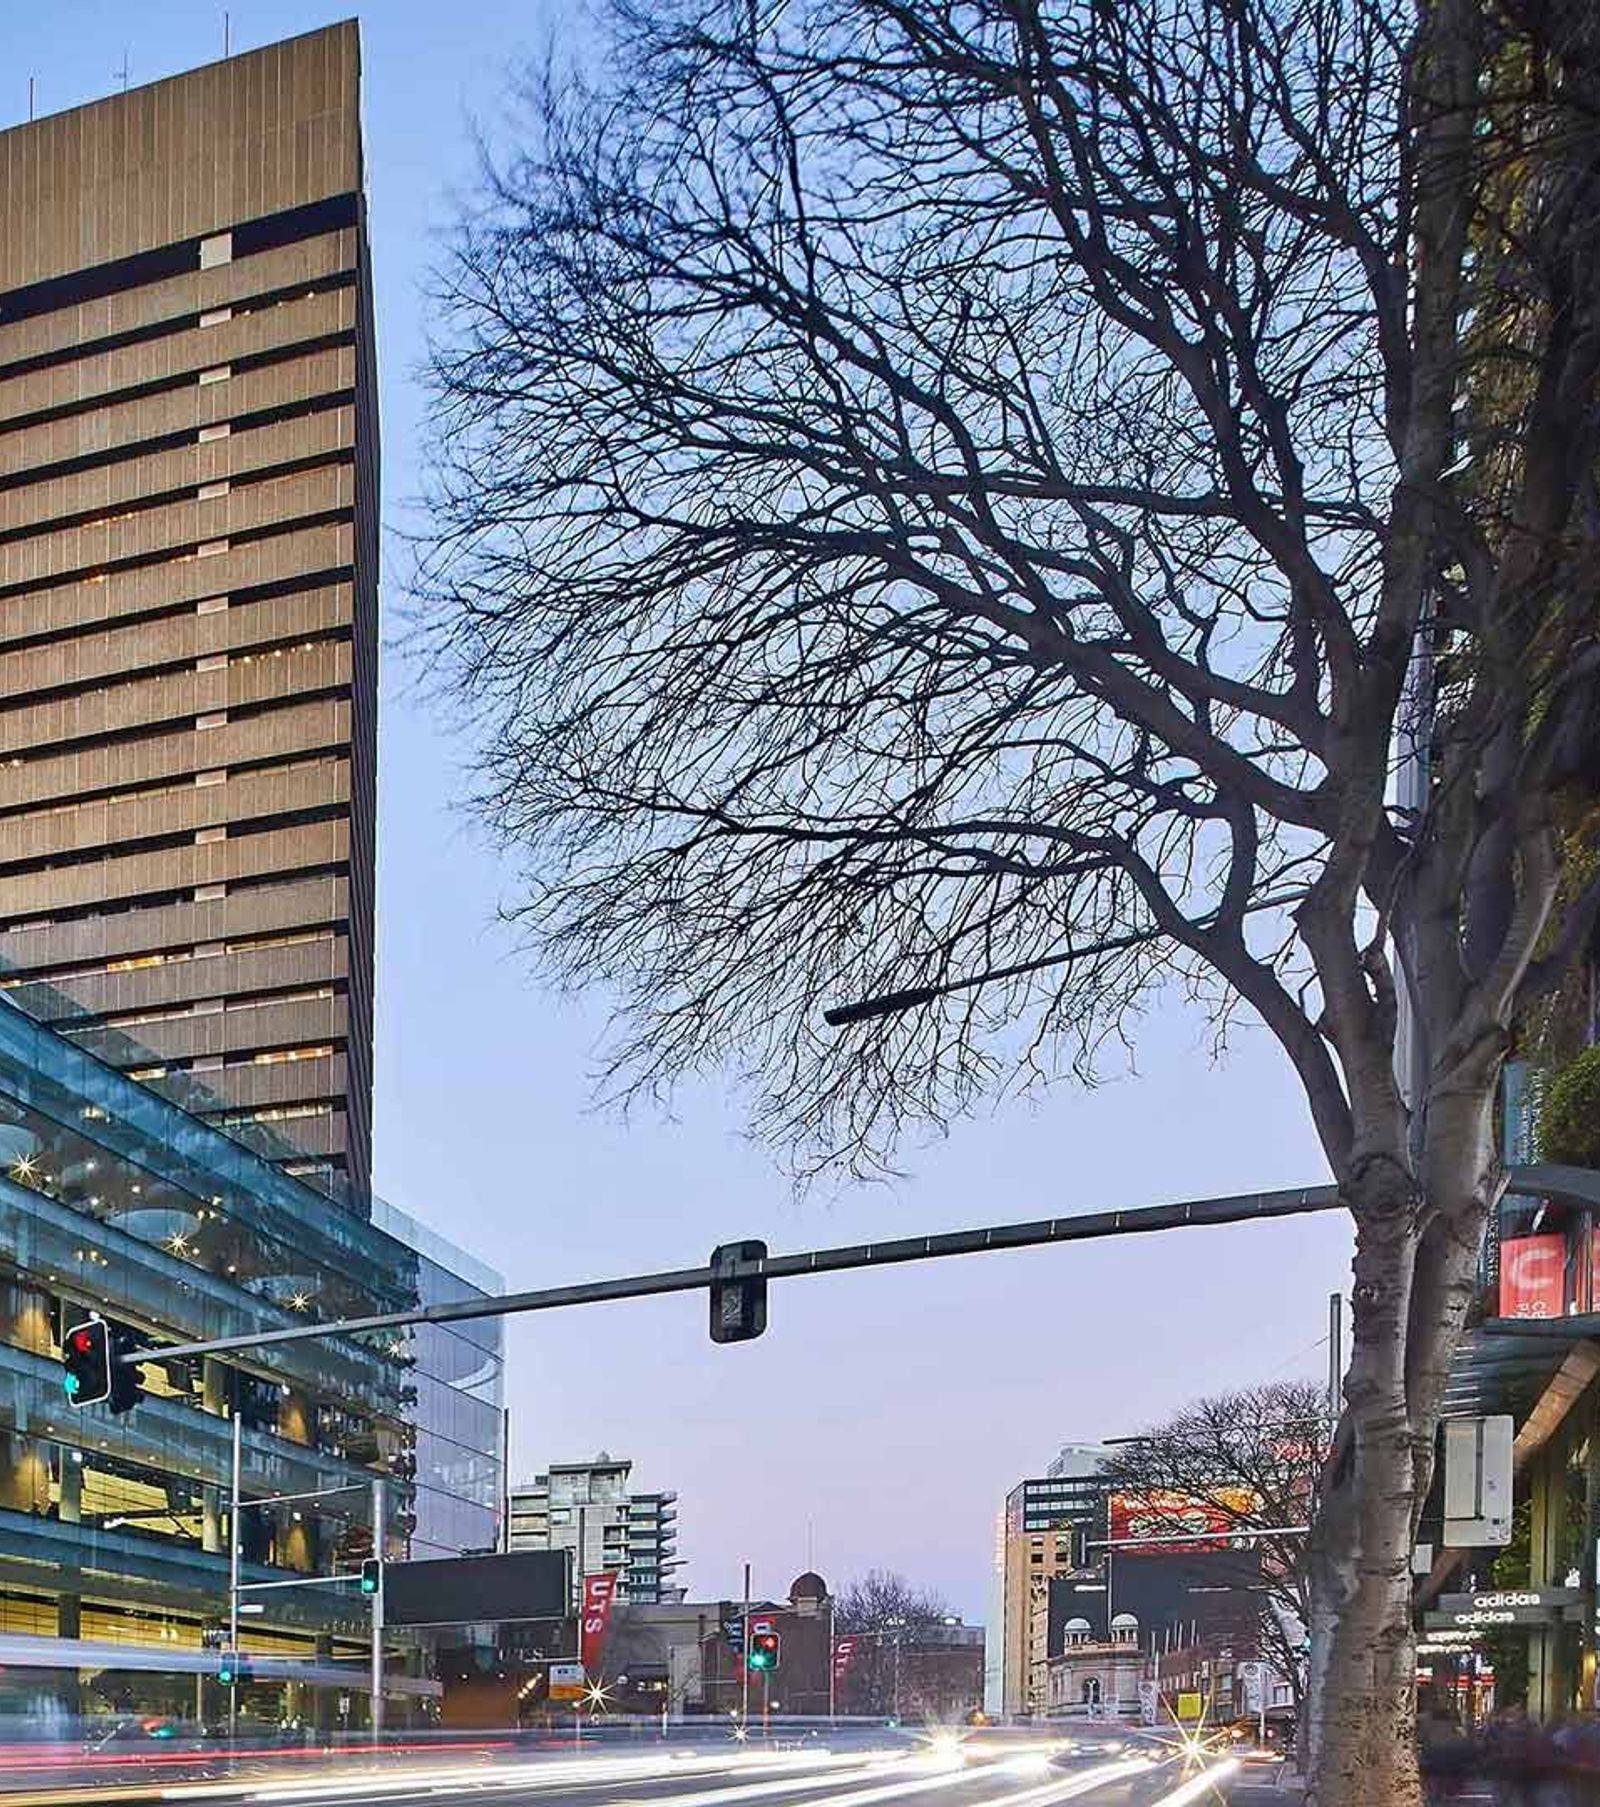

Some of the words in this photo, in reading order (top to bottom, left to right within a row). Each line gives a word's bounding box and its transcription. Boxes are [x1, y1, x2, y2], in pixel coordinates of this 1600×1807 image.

[585, 1580, 610, 1633] UTS
[1473, 1592, 1541, 1608] adidas
[1455, 1610, 1515, 1624] adidas
